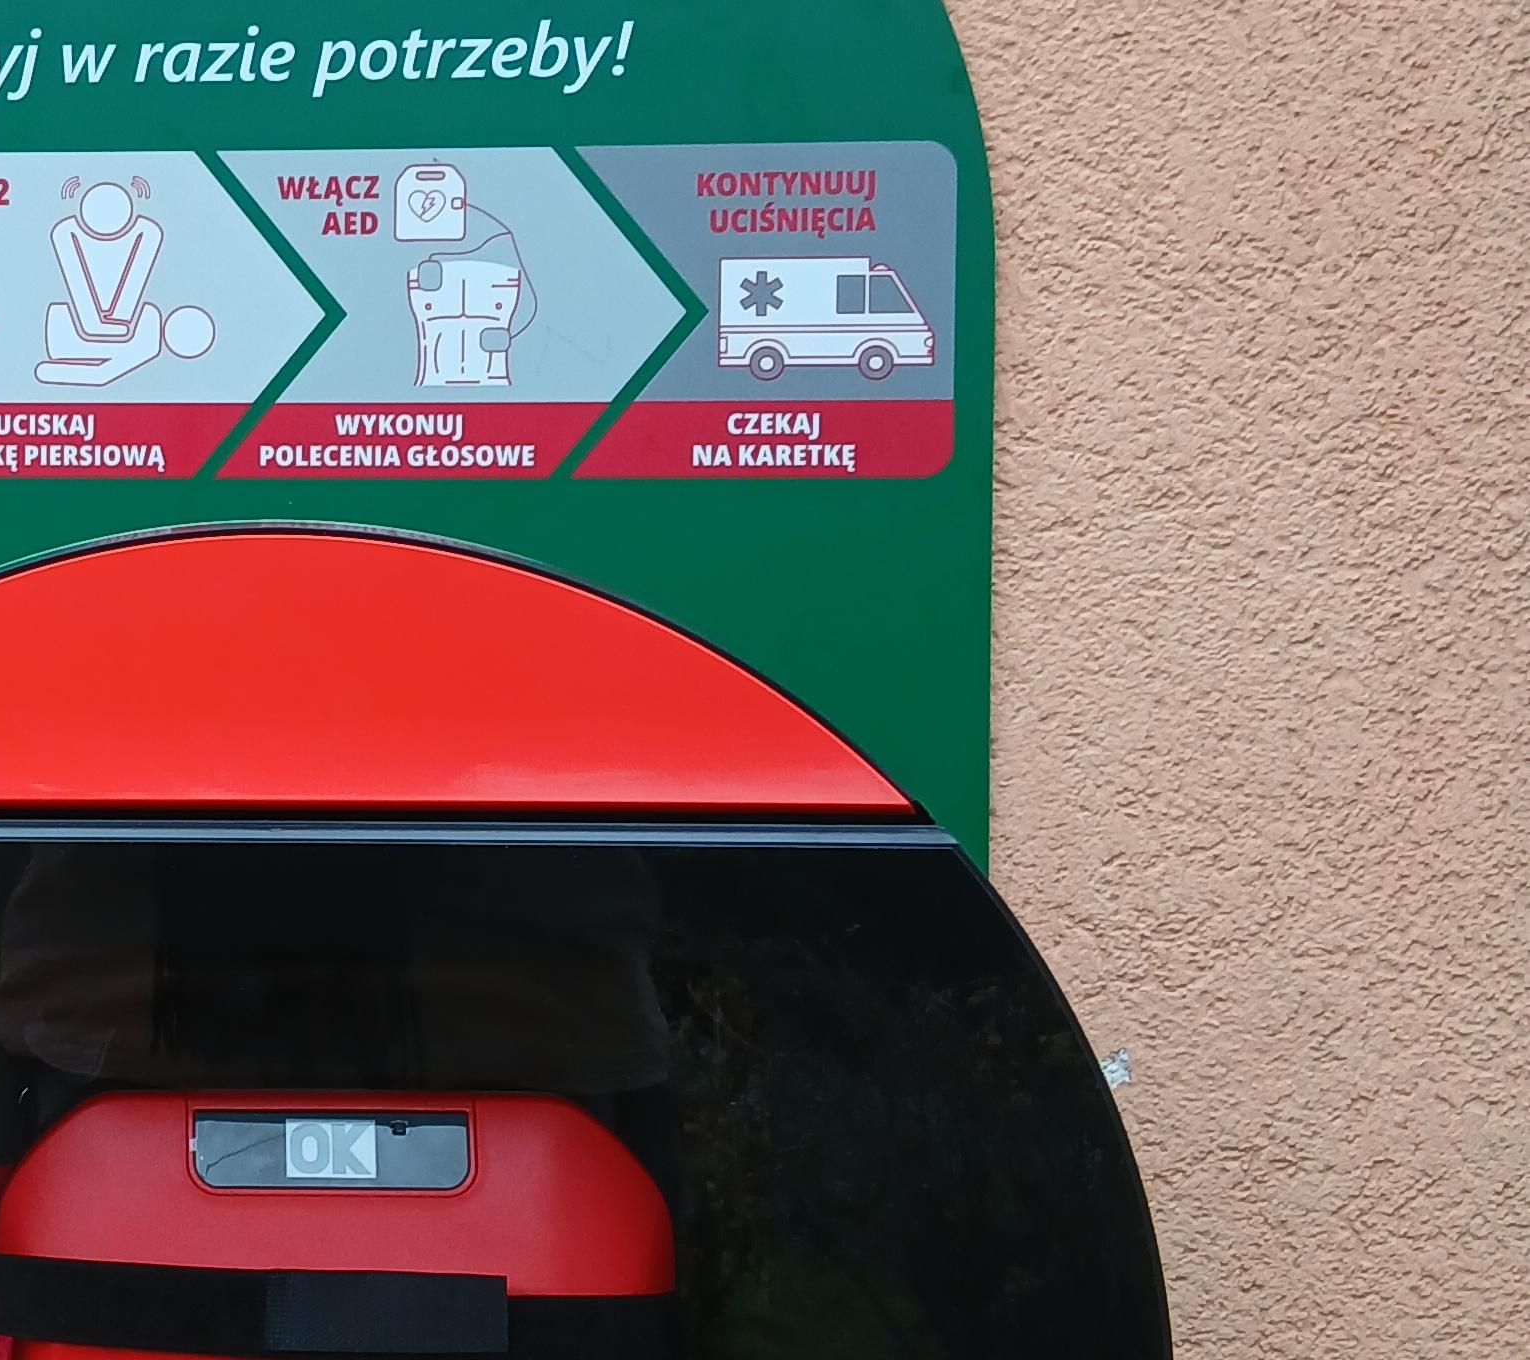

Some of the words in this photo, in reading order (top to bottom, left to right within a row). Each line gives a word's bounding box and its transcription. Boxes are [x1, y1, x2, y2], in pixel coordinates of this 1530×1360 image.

[62, 42, 117, 84] w
[134, 24, 296, 84] razie
[312, 19, 635, 99] potrzeby!
[277, 174, 380, 203] WŁĄCZ
[696, 170, 878, 201] KONTYNUUJ
[321, 211, 379, 236] AED
[708, 202, 877, 239] UCIŚNIĘCIA
[335, 413, 464, 440] WYKONUJ
[727, 411, 822, 440] CZEKAJ
[24, 443, 165, 472] PIERSIOWĄ
[258, 445, 401, 468] POLECENIA
[407, 444, 536, 468] GŁOSOWE
[691, 445, 731, 467] NA
[738, 444, 857, 473] KARETKĘ
[290, 1122, 372, 1176] OK
